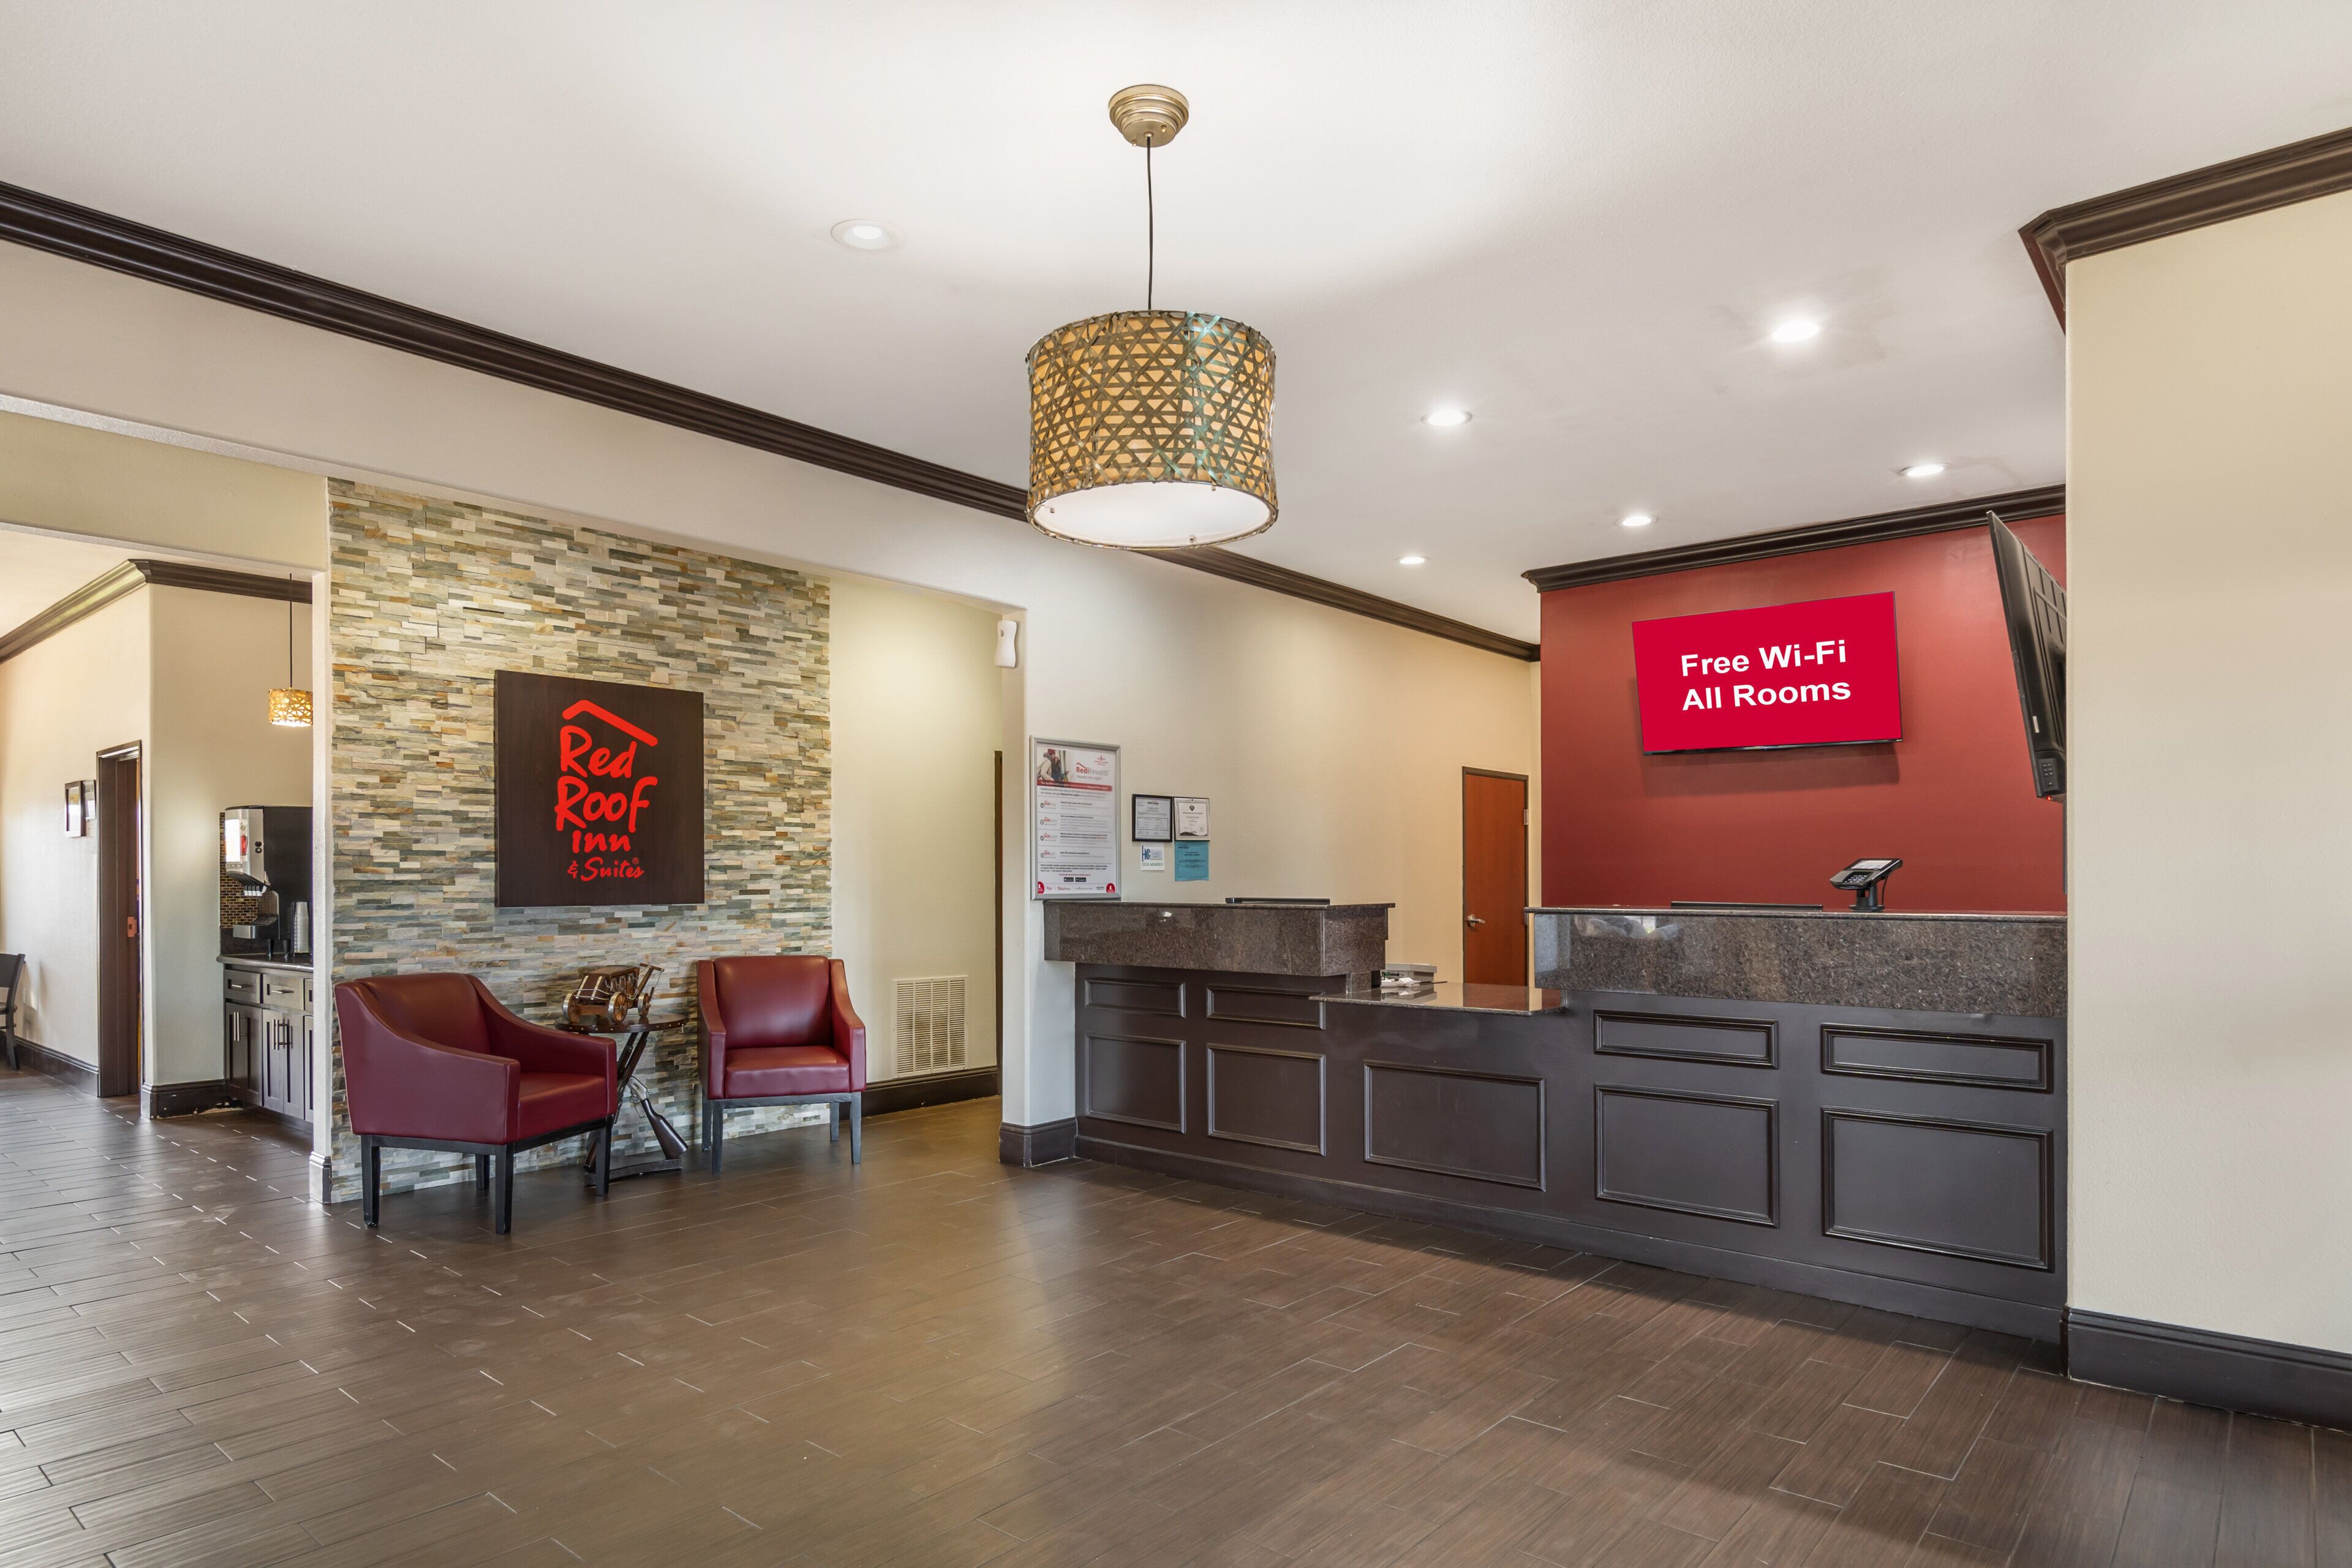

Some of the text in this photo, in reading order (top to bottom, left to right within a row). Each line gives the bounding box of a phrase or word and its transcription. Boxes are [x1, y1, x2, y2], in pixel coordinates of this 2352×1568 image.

[1681, 639, 1847, 676] Free Wi-Fi
[1682, 681, 1851, 711] All Rooms
[560, 725, 638, 778] Red
[554, 775, 658, 834] Roof
[567, 856, 645, 881] & Suites
